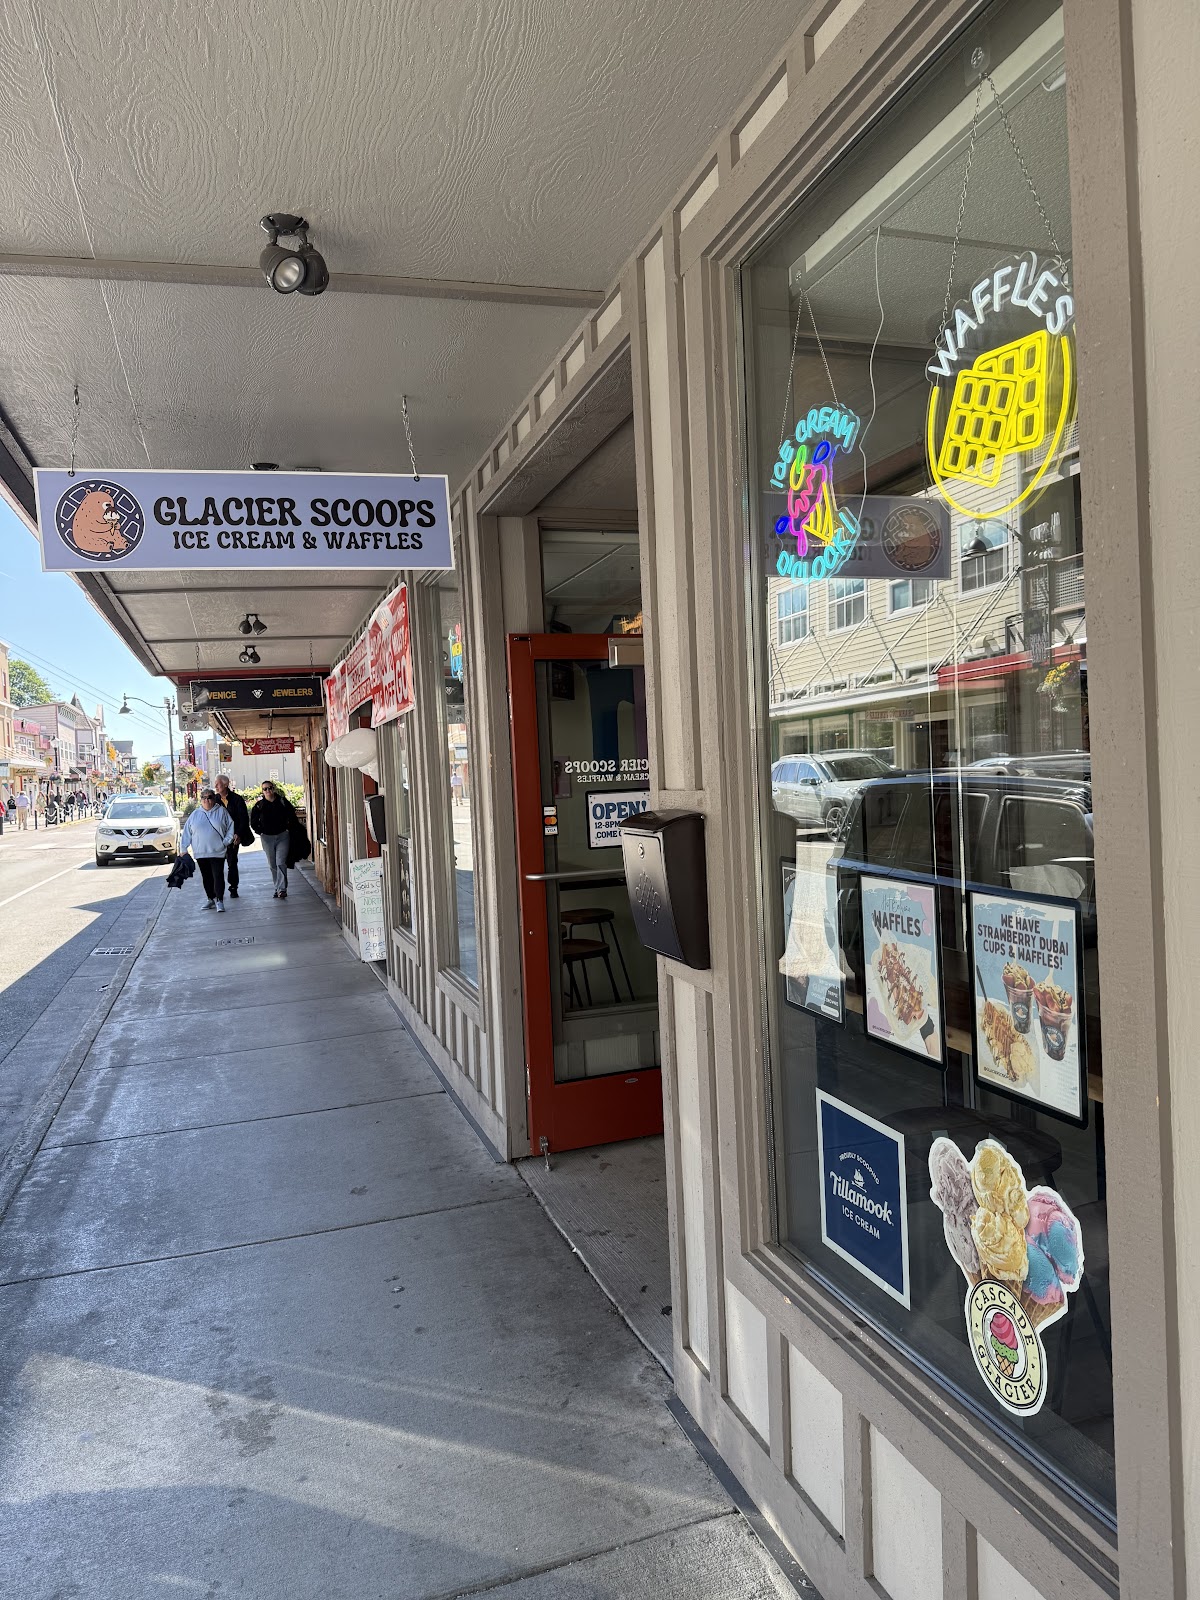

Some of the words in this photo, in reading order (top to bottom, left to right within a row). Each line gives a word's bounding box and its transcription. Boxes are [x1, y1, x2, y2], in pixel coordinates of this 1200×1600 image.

[928, 261, 1073, 376] WAFFLES
[770, 440, 794, 488] ICE
[795, 407, 855, 448] CREAM
[153, 496, 302, 527] GLACIER
[310, 498, 436, 528] SCOOPS
[173, 531, 209, 550] ICE
[216, 531, 295, 550] CREAM
[302, 532, 318, 549] &
[324, 532, 423, 551] WAFFLES
[207, 690, 237, 700] VENICE
[272, 688, 313, 698] JEWELERS
[592, 800, 647, 820] OPEN!
[596, 830, 618, 839] COME
[874, 909, 921, 937] WAFFLES
[1000, 913, 1014, 929] WE
[1015, 916, 1041, 935] HAVE
[977, 924, 1037, 948] STRAWBERRY
[1039, 936, 1069, 956] DUBAI
[983, 939, 1006, 956] CUPS
[1008, 945, 1015, 959] &
[1017, 947, 1063, 970] WAFFLES!
[839, 1151, 857, 1162] PROUDLY
[856, 1154, 880, 1185] SCOOPING
[829, 1170, 893, 1226] Tillamook
[841, 1205, 854, 1221] ICE
[854, 1214, 881, 1240] CREAM
[974, 1287, 1036, 1347] CASCADE
[976, 1343, 1038, 1402] GLACIER
